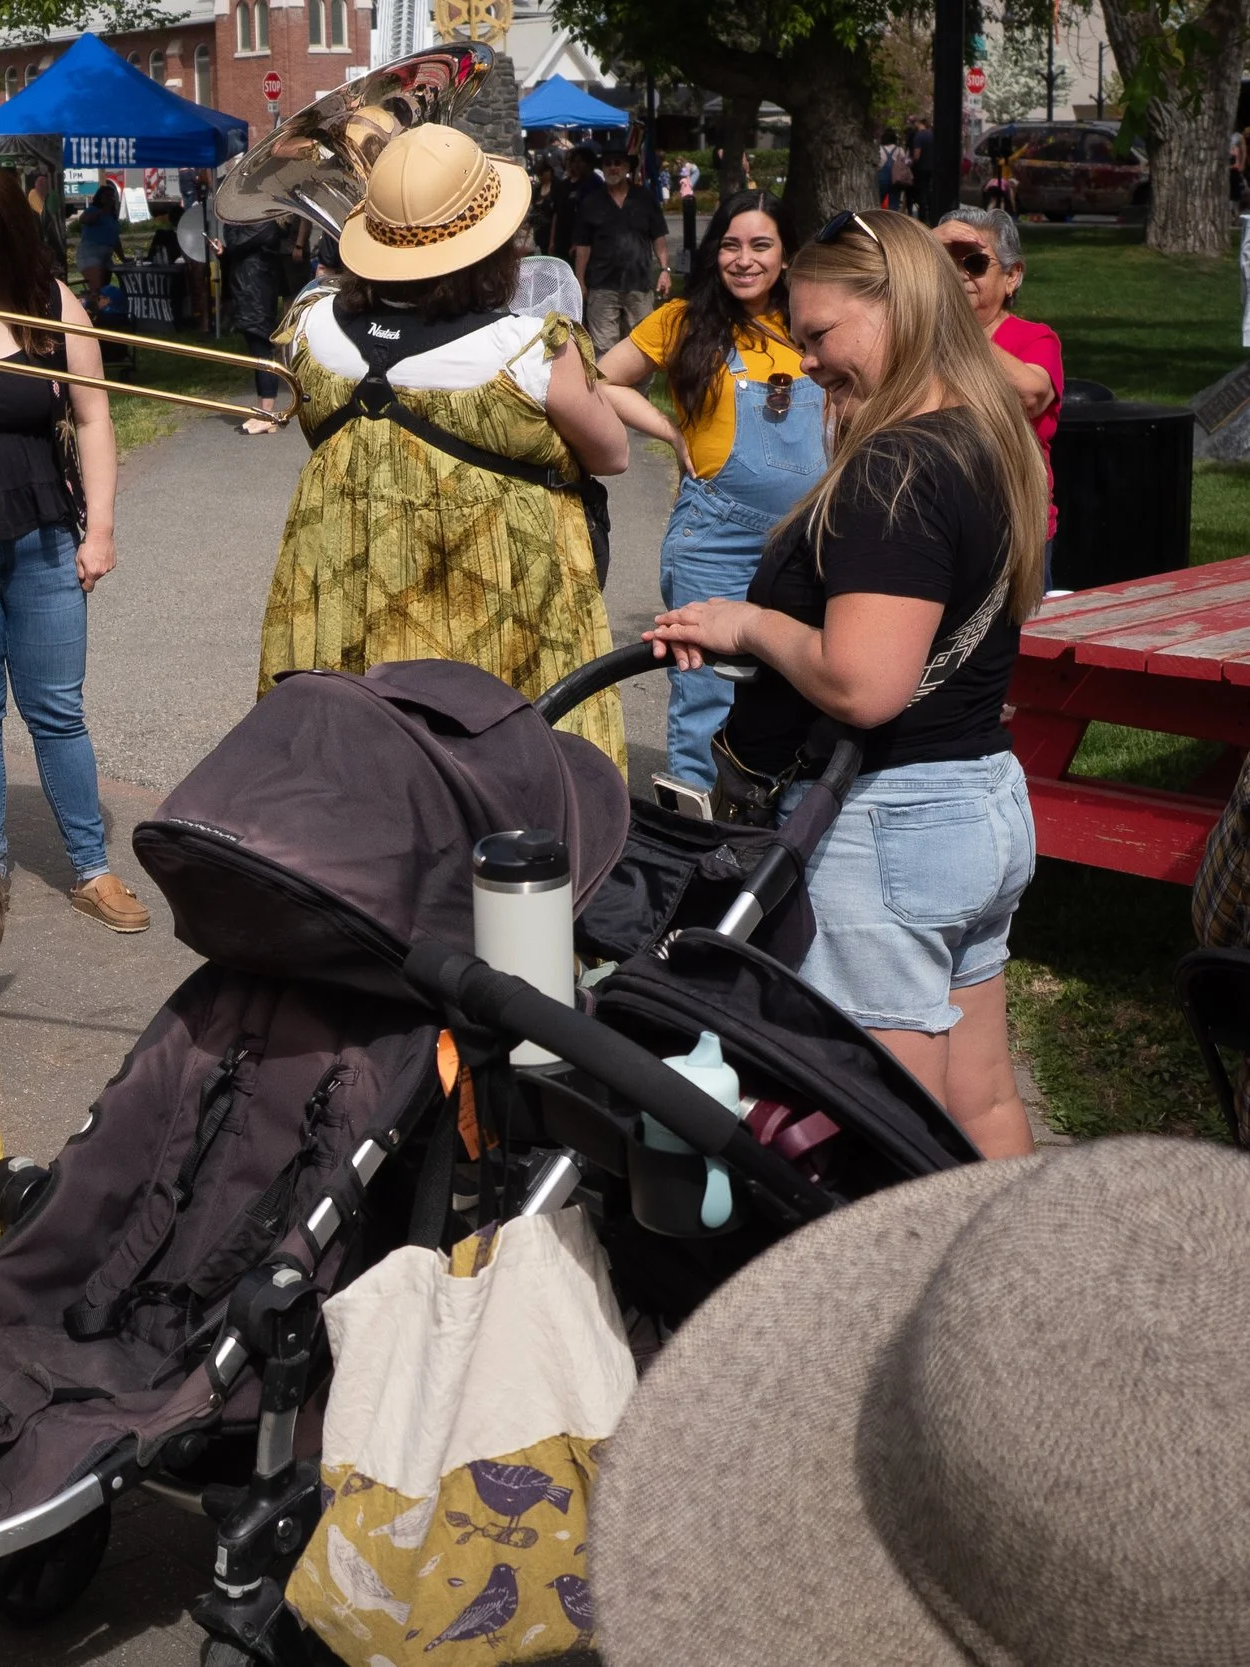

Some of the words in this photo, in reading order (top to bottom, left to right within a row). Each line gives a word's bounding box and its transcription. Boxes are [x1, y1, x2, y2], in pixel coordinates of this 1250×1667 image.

[264, 80, 281, 92] STOP
[966, 74, 984, 86] STOP
[70, 137, 136, 164] THEATRE
